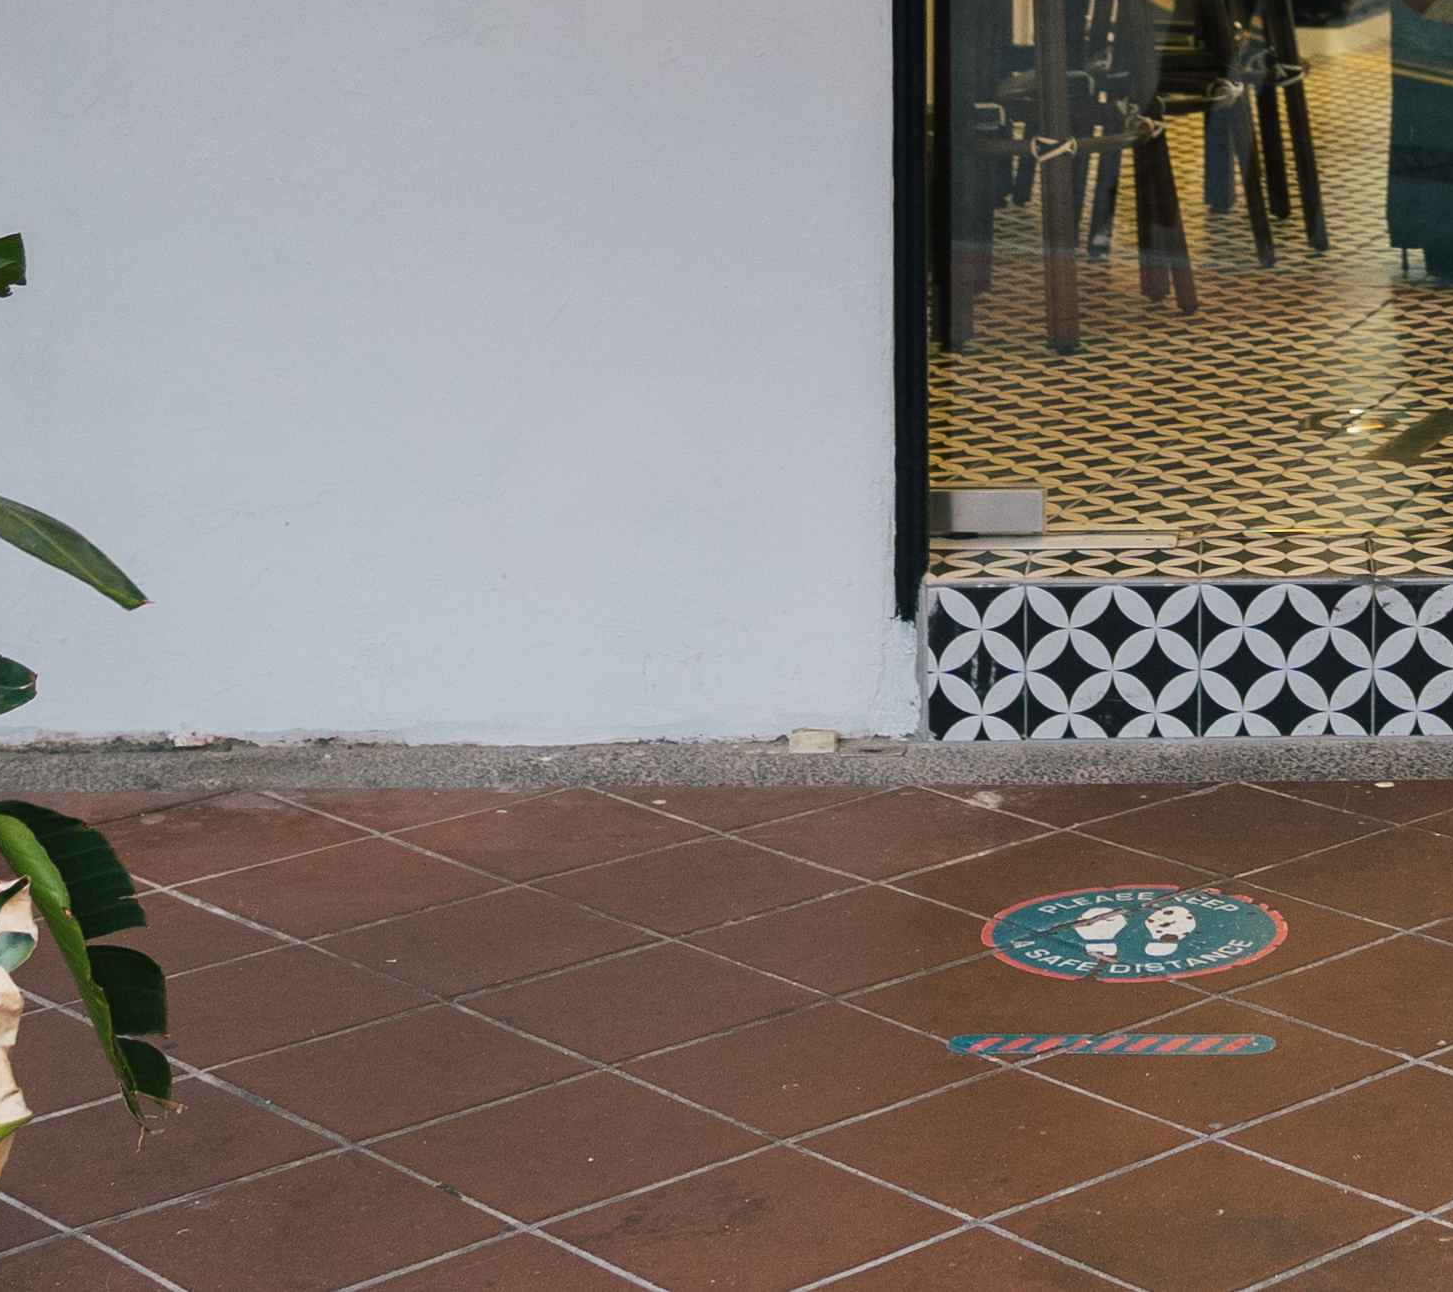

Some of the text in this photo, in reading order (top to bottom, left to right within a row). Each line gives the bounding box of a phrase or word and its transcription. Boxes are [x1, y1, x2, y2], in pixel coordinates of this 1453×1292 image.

[1038, 891, 1154, 914] PLEASE
[1026, 949, 1098, 971] SAFE
[1109, 939, 1254, 974] DISTANCE
